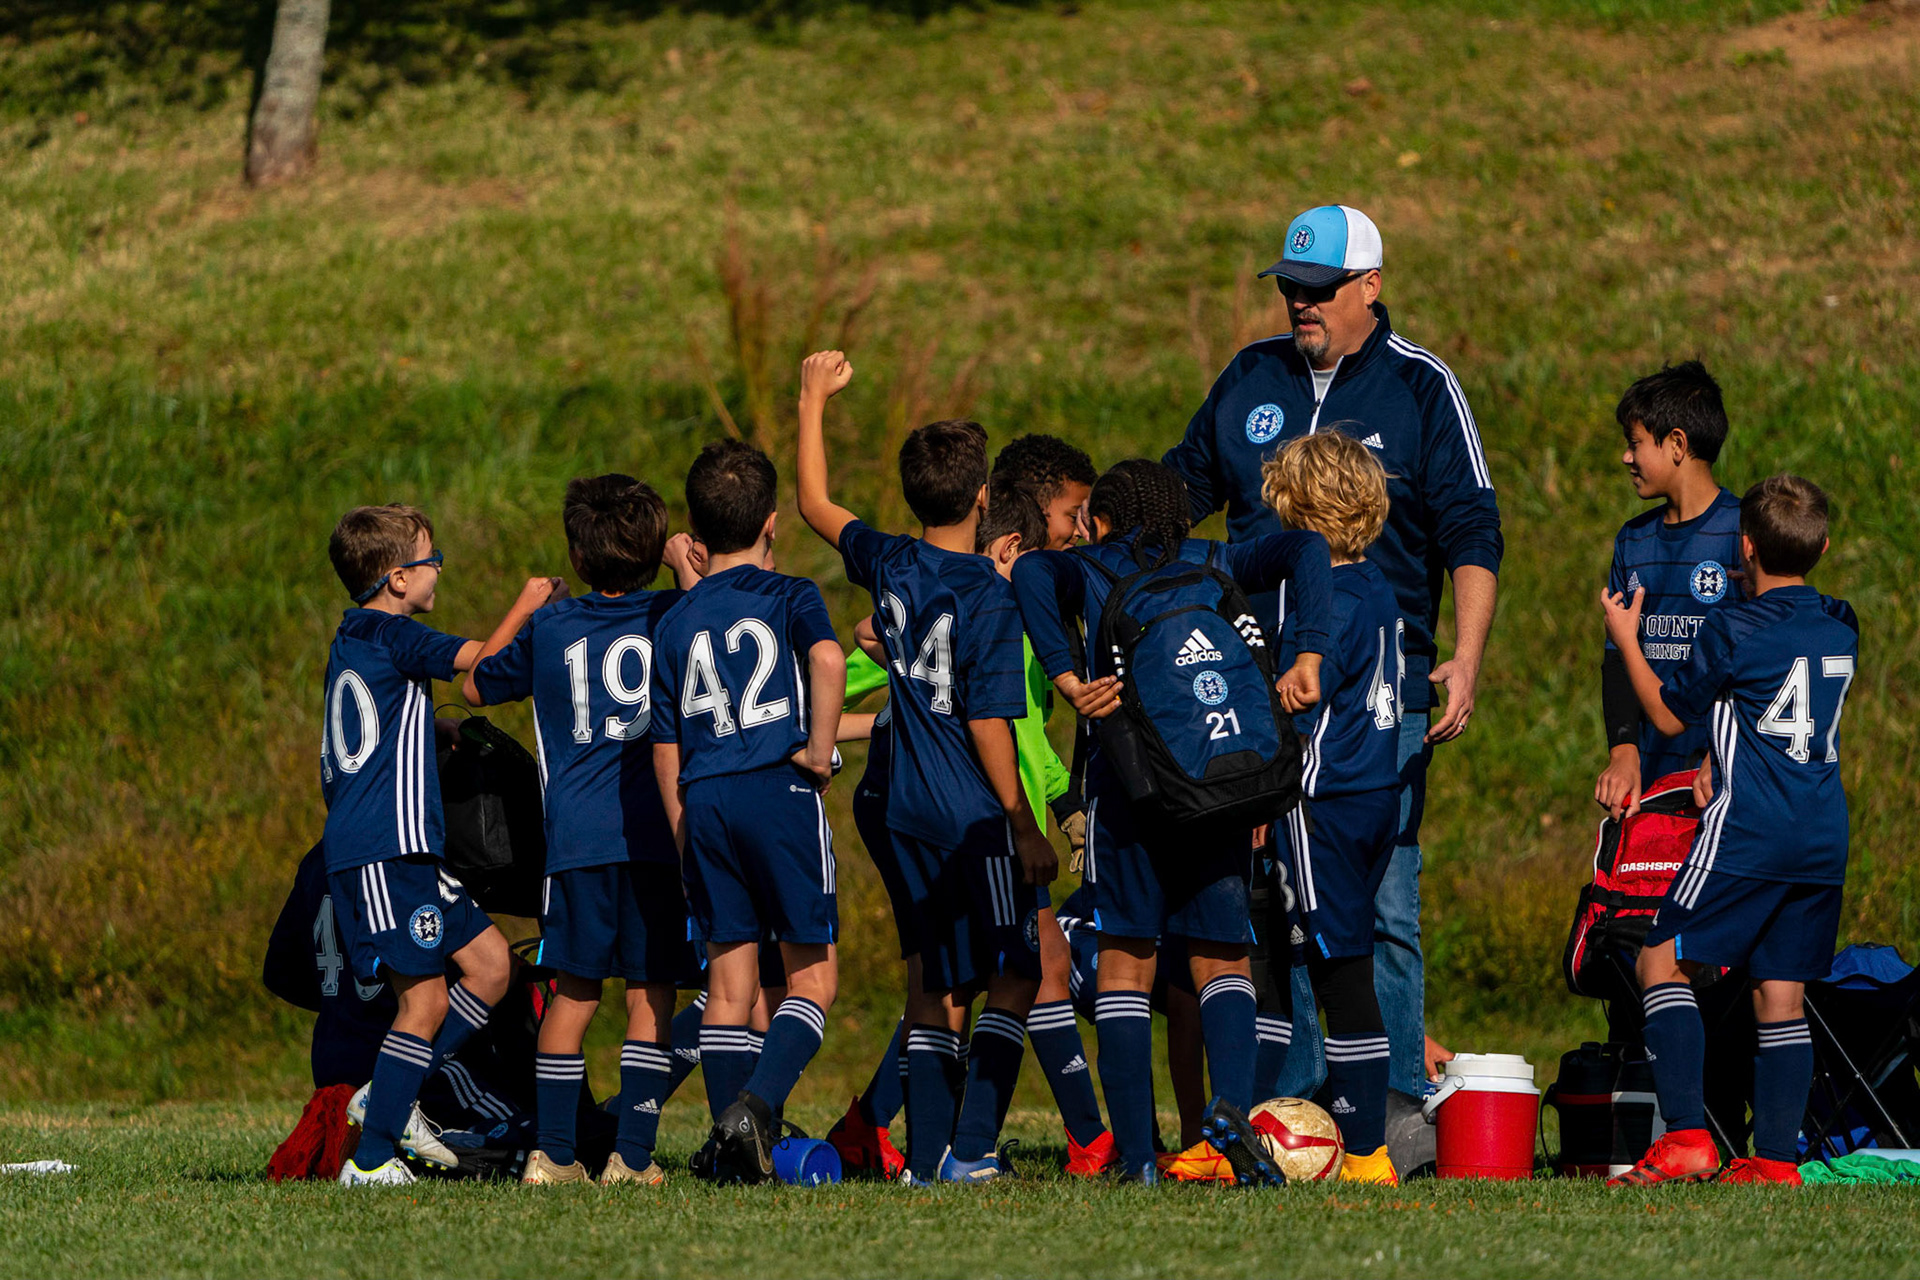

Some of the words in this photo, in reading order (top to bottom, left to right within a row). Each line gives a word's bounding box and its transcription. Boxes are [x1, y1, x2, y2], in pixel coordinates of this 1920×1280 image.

[564, 634, 653, 743] 19
[681, 617, 791, 738] 42
[1175, 648, 1223, 667] adidas
[1757, 655, 1854, 763] 47
[1205, 707, 1242, 741] 21
